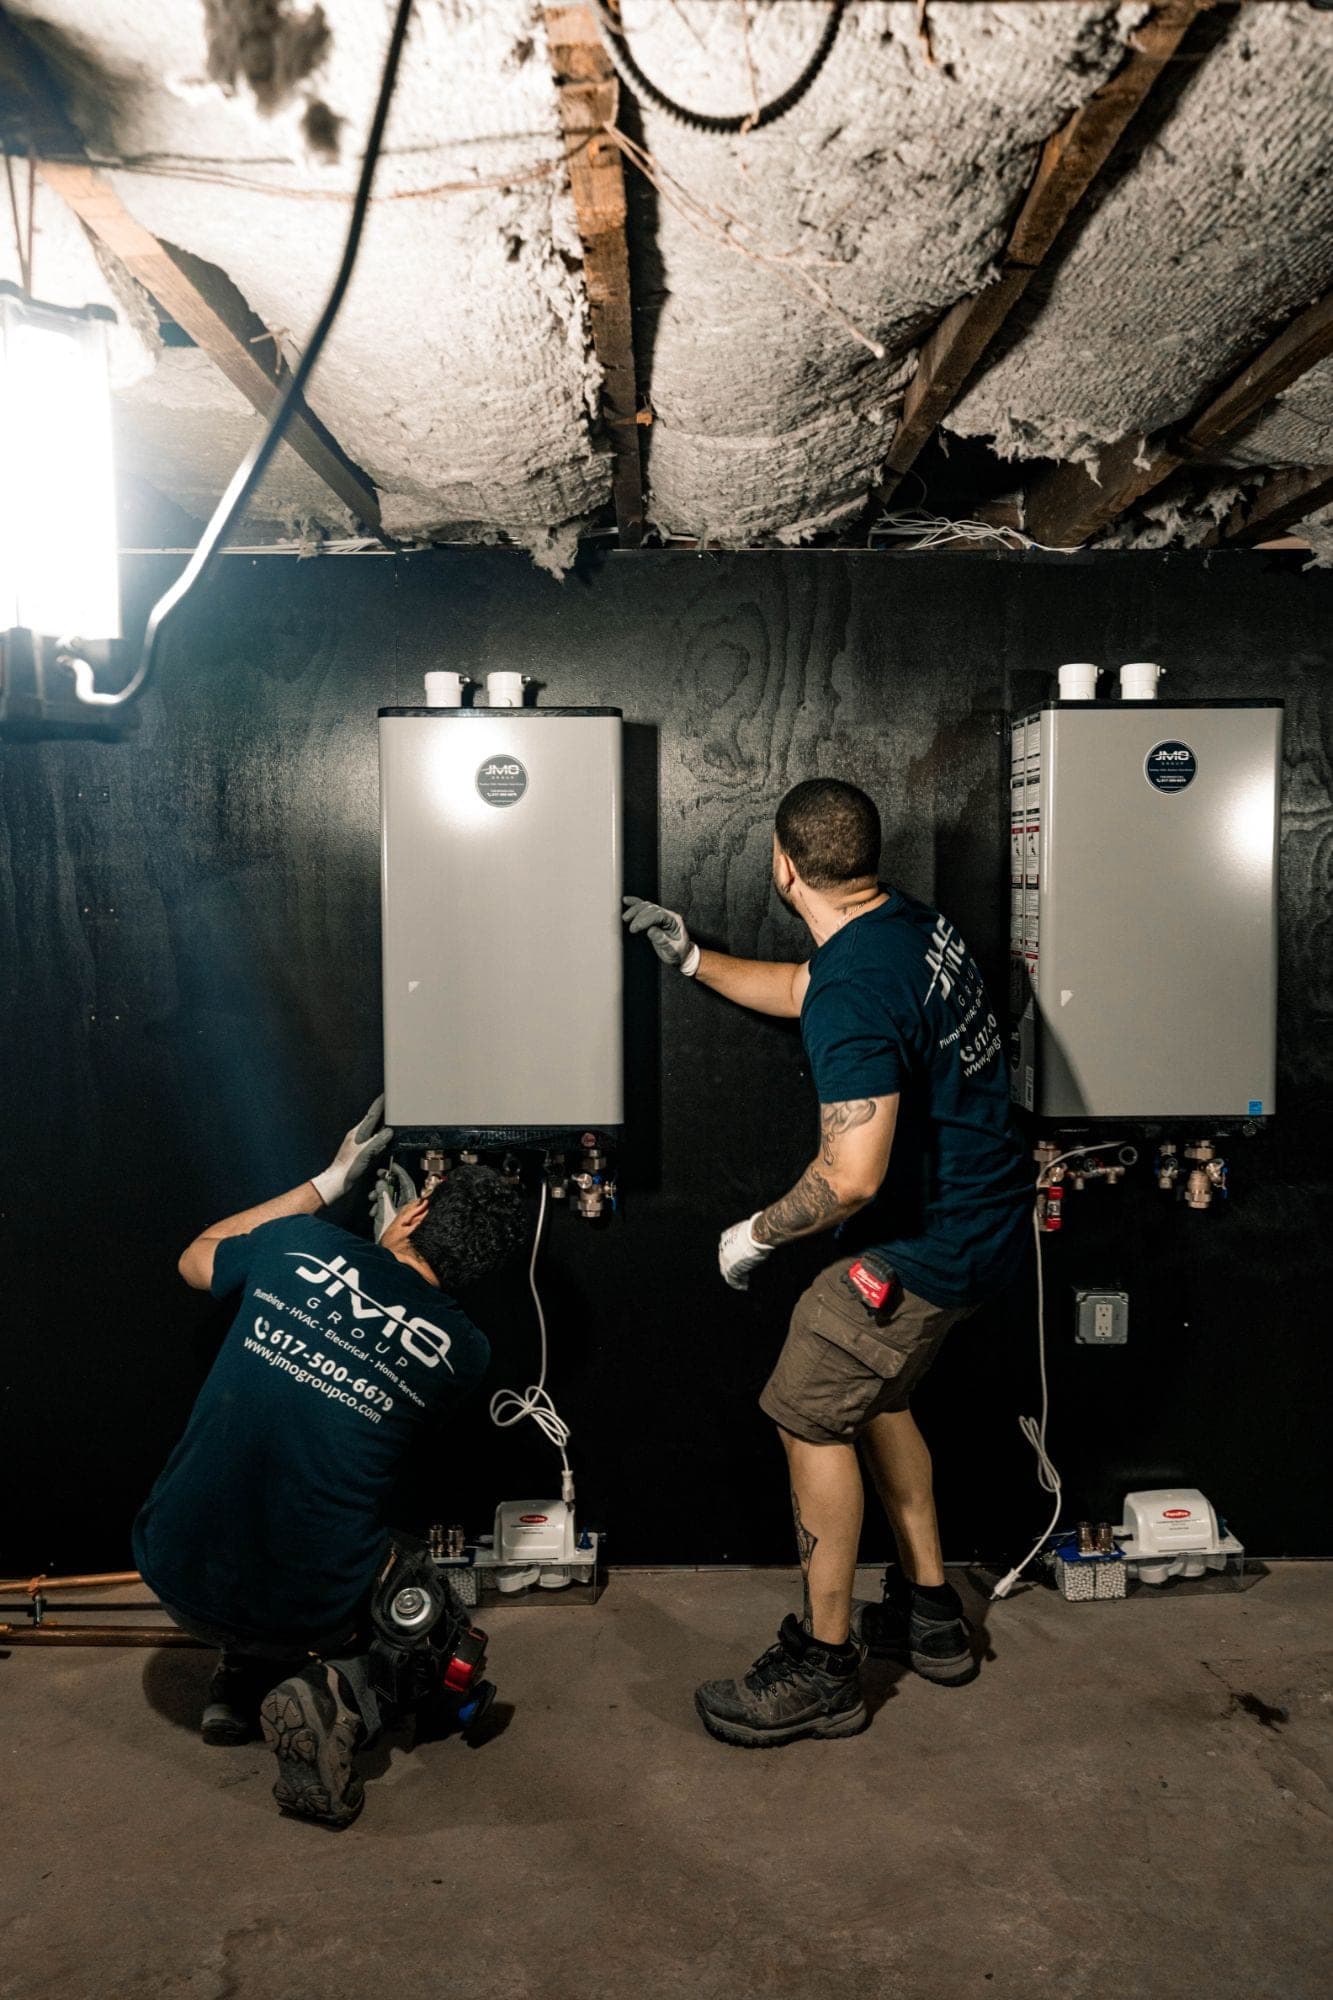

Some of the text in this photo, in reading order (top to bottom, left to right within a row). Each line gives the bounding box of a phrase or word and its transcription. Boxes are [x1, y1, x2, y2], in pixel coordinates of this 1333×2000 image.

[485, 764, 519, 775] JMO
[1154, 750, 1189, 761] JMO
[289, 1306, 320, 1330] HVAC
[324, 1328, 370, 1361] Electrical
[374, 1360, 400, 1384] Home
[294, 1254, 453, 1369] JMO
[305, 1296, 409, 1368] GROUP
[243, 1336, 383, 1424] www.jmogroupco.com
[269, 1328, 395, 1412] 617-500-6679
